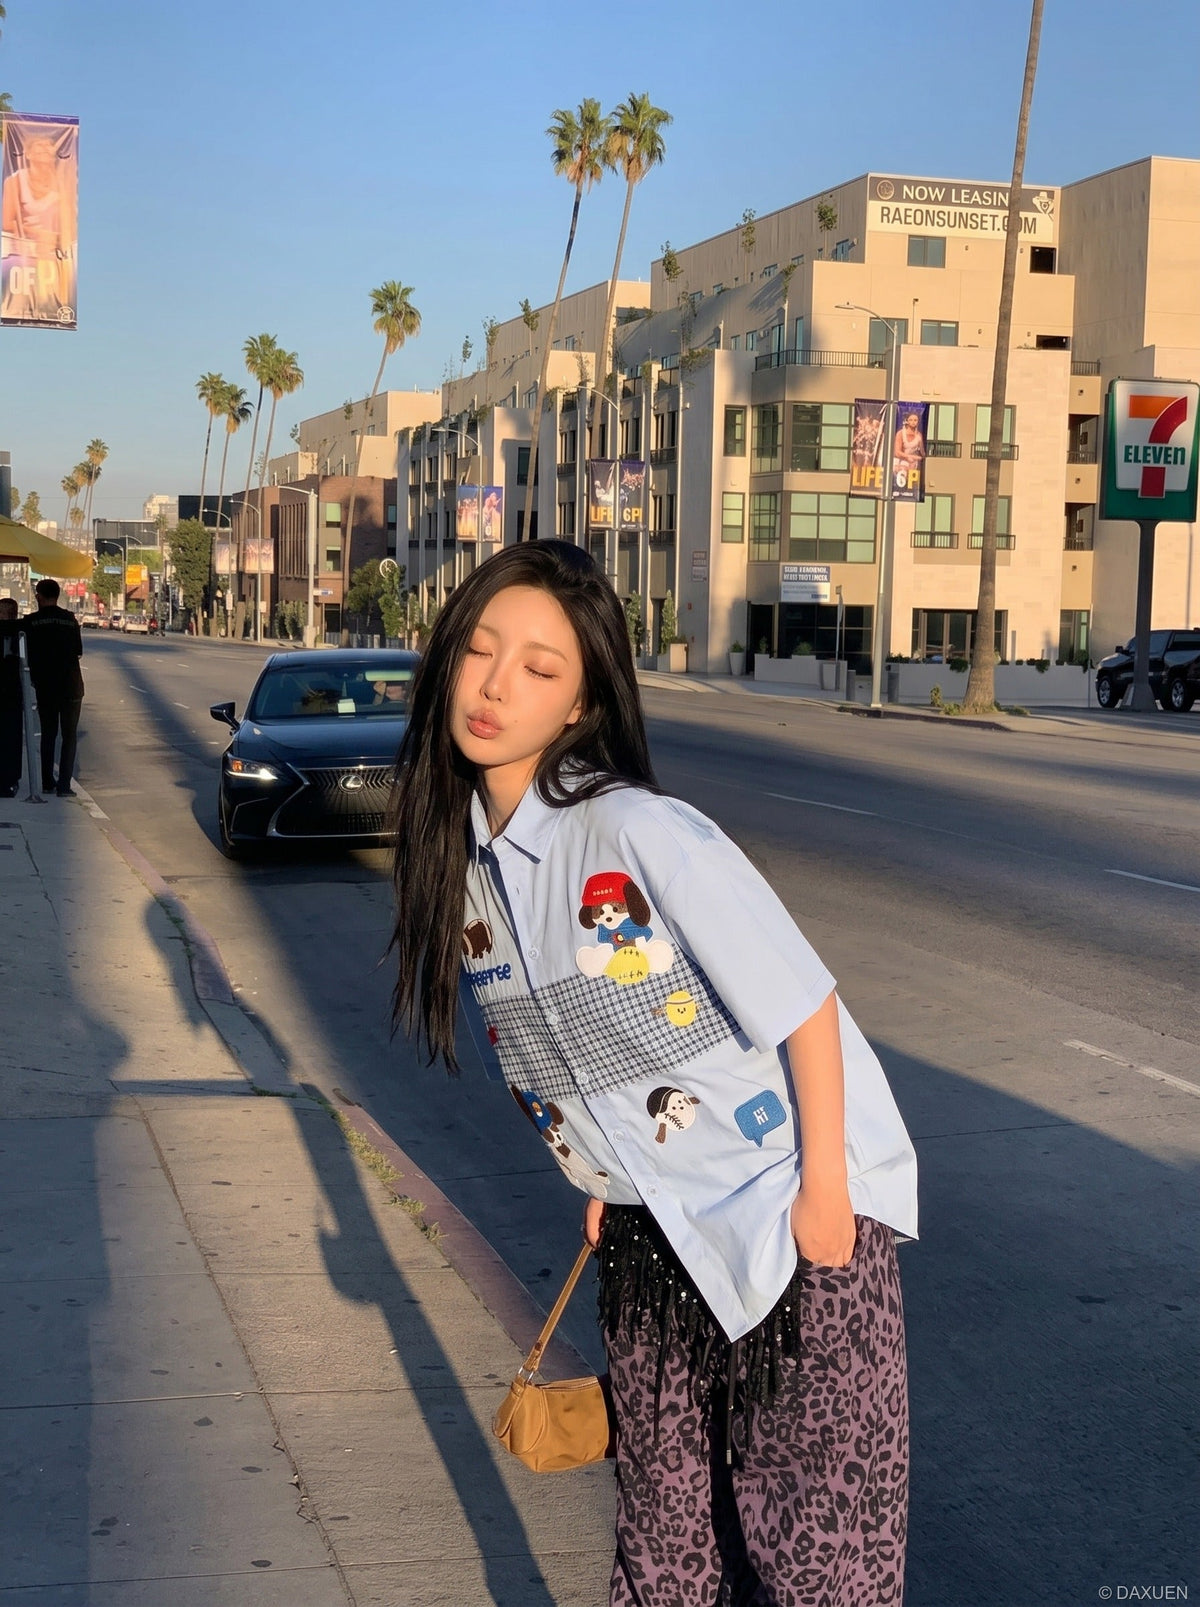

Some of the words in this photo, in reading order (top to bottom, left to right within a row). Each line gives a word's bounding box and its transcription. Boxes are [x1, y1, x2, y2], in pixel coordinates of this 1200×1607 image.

[902, 184, 946, 202] NOW
[951, 188, 1010, 207] LEASIN
[1128, 395, 1188, 498] 7
[852, 465, 884, 488] LIFE
